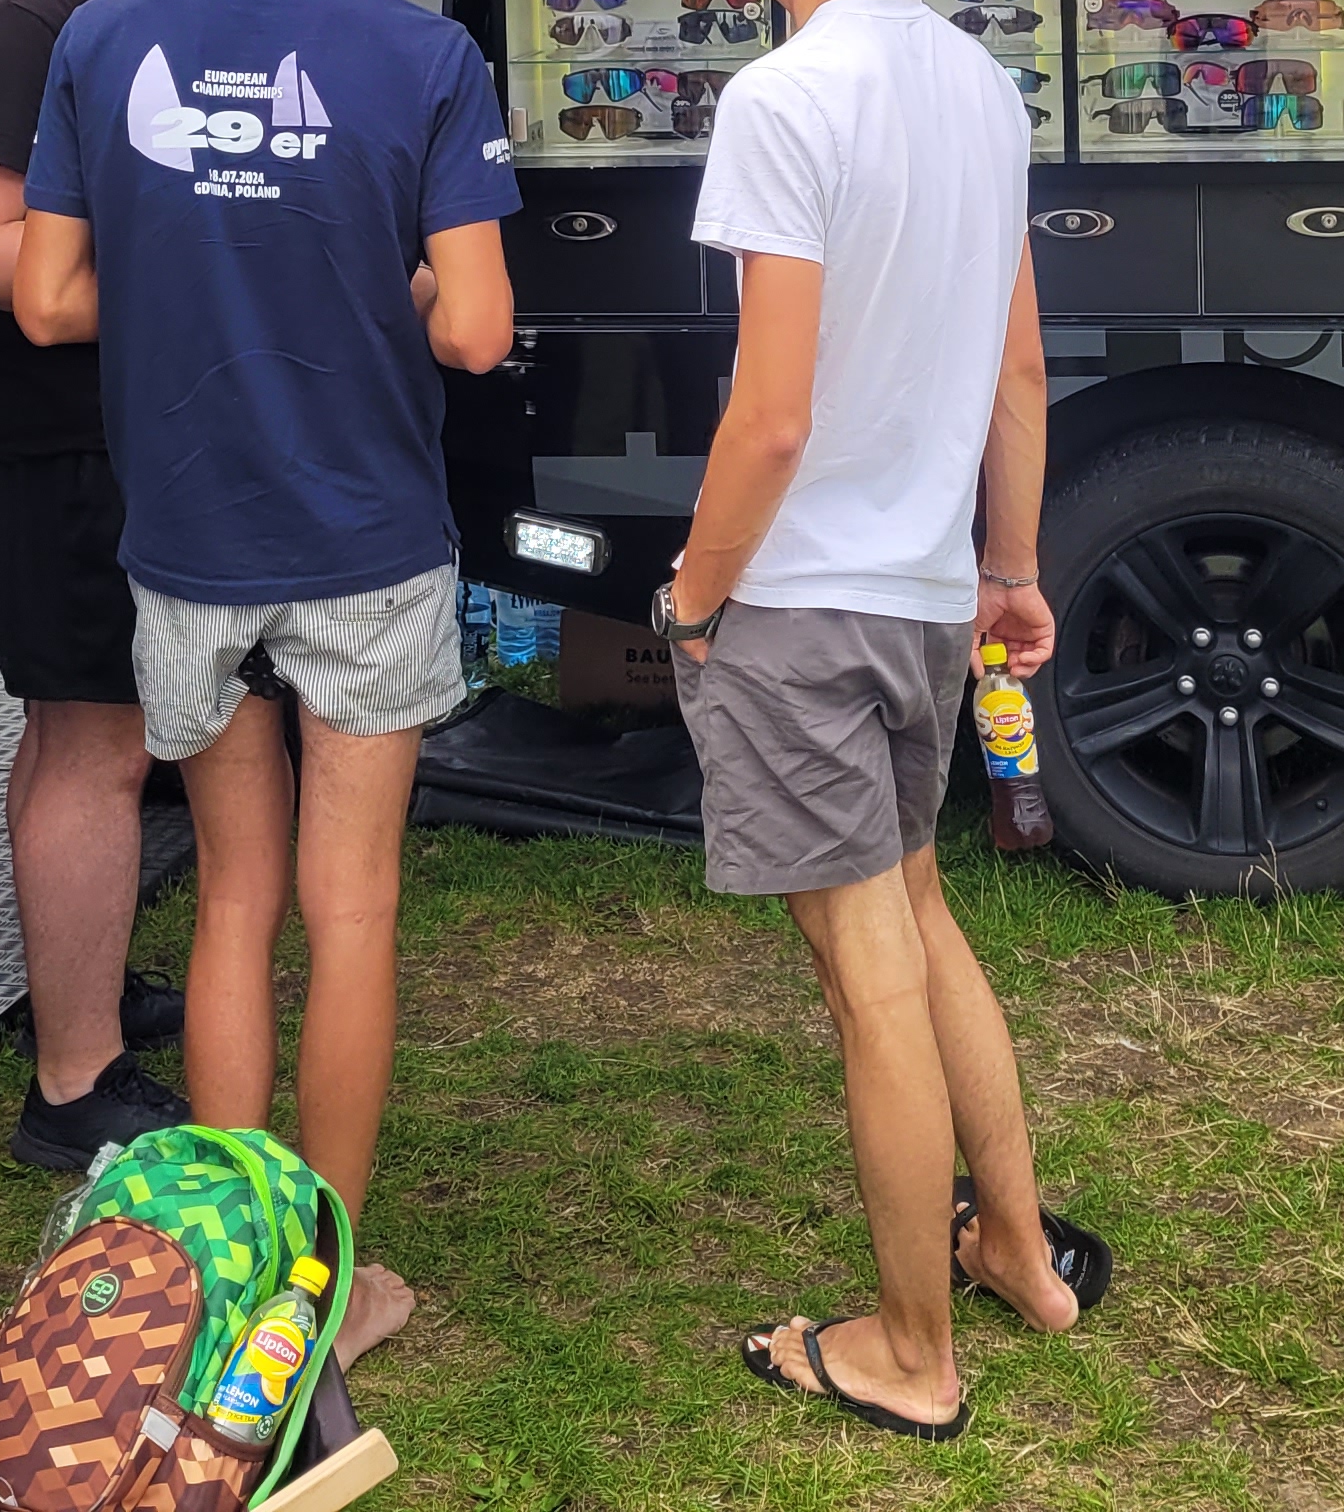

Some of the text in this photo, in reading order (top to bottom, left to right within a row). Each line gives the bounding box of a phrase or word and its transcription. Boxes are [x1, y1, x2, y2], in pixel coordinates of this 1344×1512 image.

[204, 69, 268, 86] EUROPEAN
[192, 80, 284, 99] CHAMPIONSHIPS
[235, 184, 281, 199] POLAND
[995, 715, 1019, 725] Lipton
[255, 1330, 298, 1365] Lipton
[225, 1383, 260, 1409] LEMON
